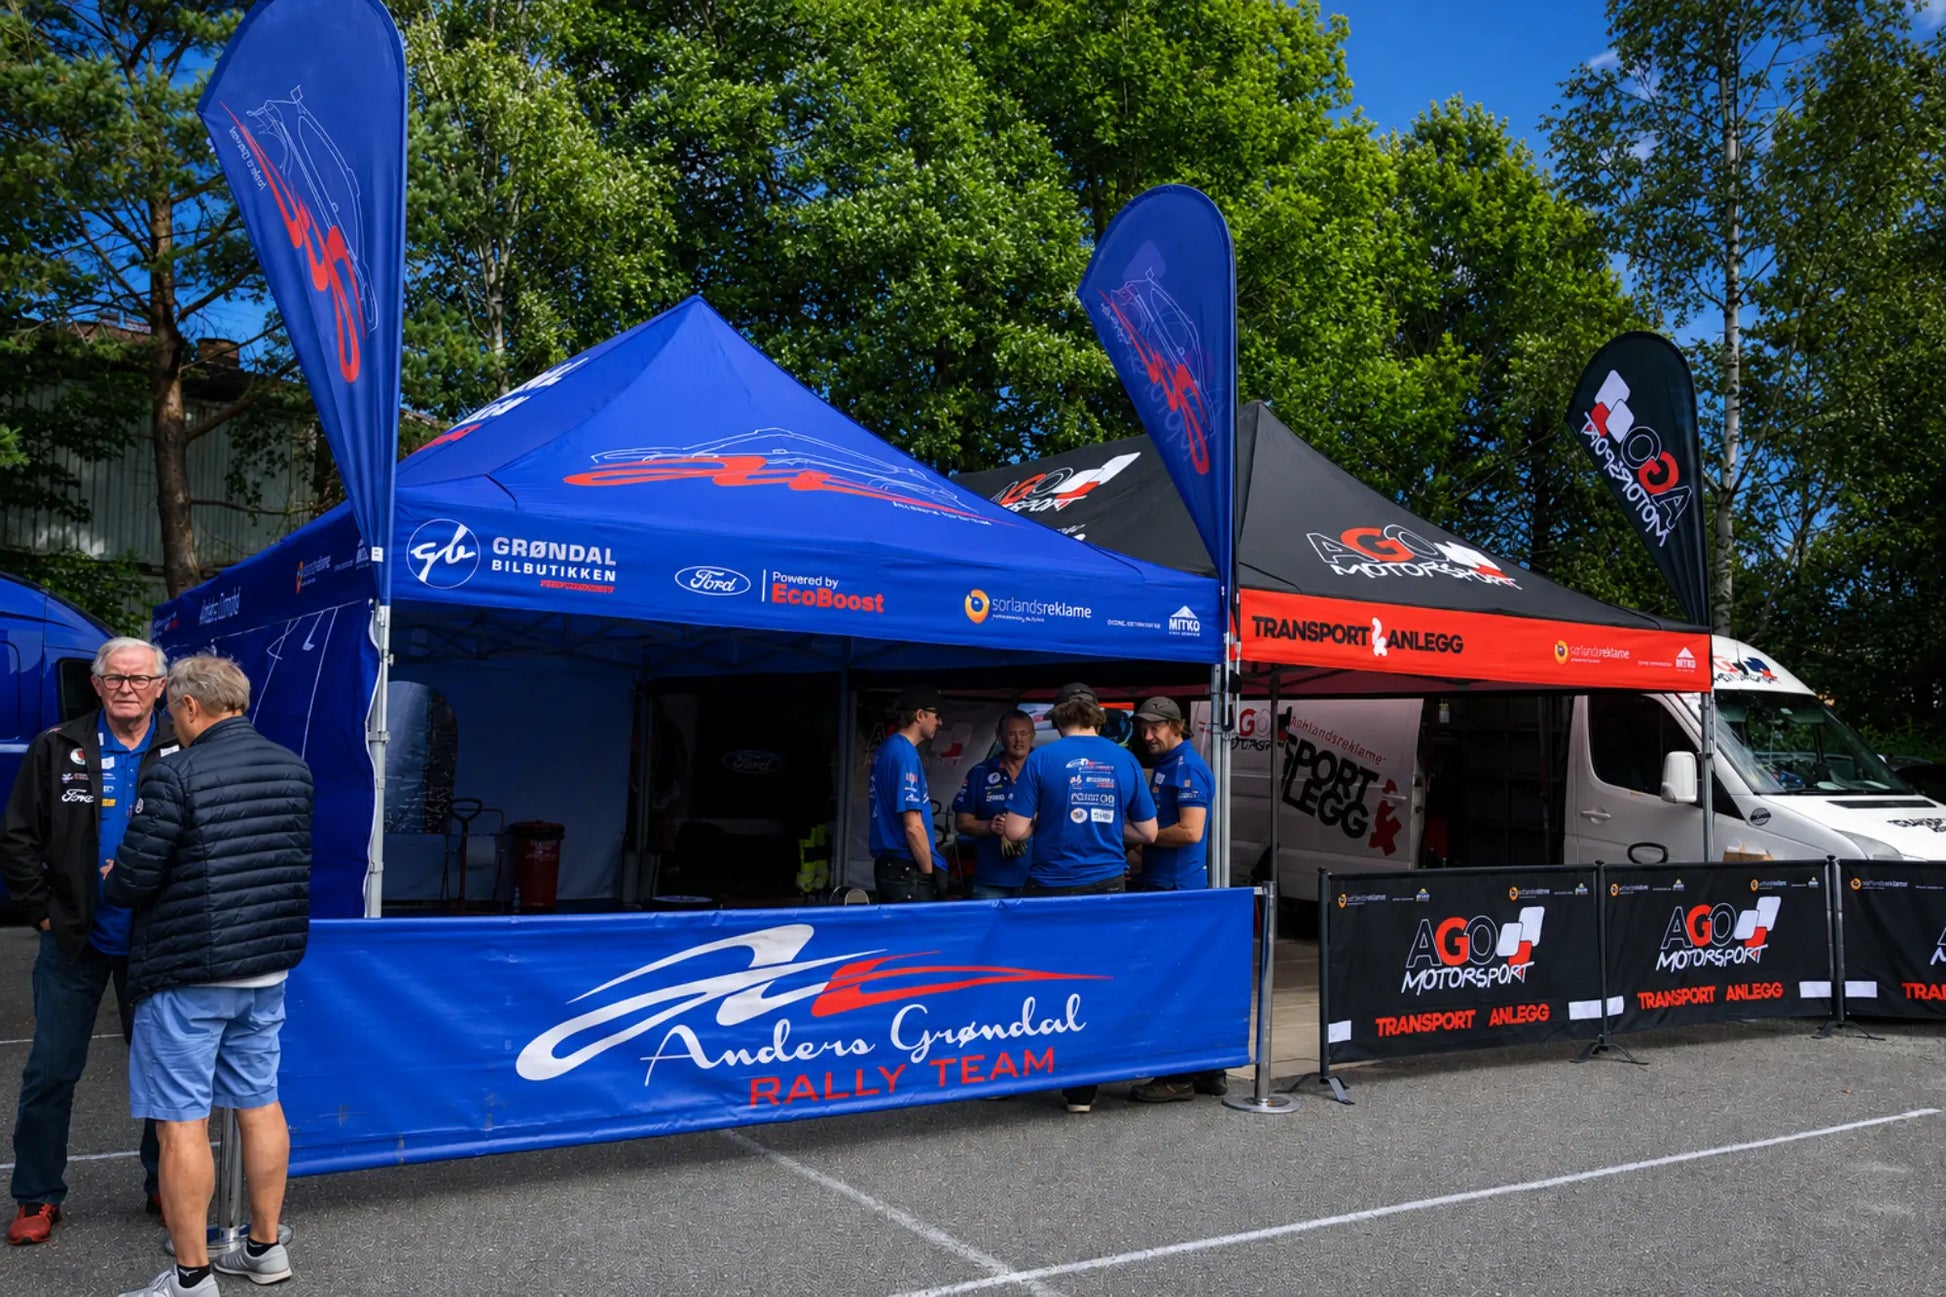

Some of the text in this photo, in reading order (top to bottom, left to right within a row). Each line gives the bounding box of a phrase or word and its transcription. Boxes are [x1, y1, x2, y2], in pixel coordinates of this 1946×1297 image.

[492, 536, 617, 566] GRØNDAL
[1306, 524, 1449, 564] AGO
[492, 559, 616, 582] BILBUTIKKEN
[690, 569, 738, 592] Ford
[772, 571, 838, 589] Powered by
[1331, 560, 1523, 590] MOTORSPORT
[771, 583, 884, 613] EcoBoost
[1251, 615, 1370, 647] TRANSPORT
[1386, 629, 1464, 653] ANLEGG
[1406, 915, 1499, 968] AGO
[1660, 902, 1738, 950] AGO
[1656, 944, 1768, 973] MOTORSPORT
[1401, 961, 1535, 996] MOTORSPORT
[1637, 982, 1783, 1010] TRANSPORT ANLEGG
[1375, 1003, 1549, 1037] TRANSPORT ANLEGG
[640, 993, 1087, 1087] Anders Grøndal
[749, 1047, 1055, 1108] RALLY TEAM
